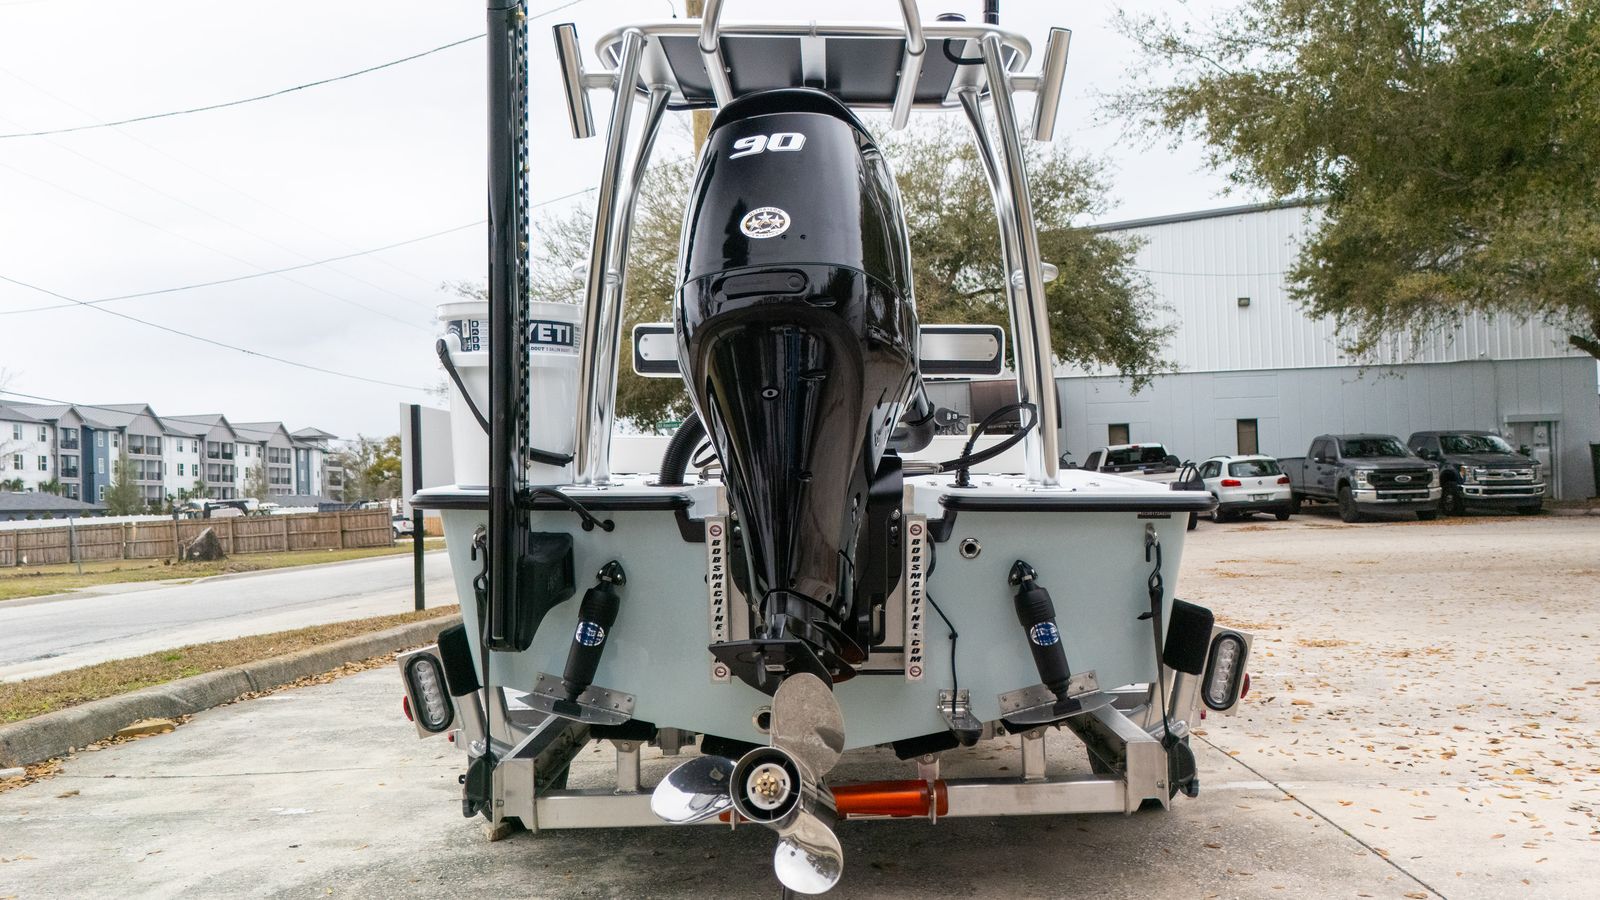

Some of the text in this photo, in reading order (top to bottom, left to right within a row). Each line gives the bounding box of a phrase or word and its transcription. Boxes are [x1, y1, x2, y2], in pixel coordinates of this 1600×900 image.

[729, 132, 807, 160] 90
[711, 539, 725, 665] BOBSMACHINE.
[910, 538, 923, 664] BOBSMACHINE.COM
